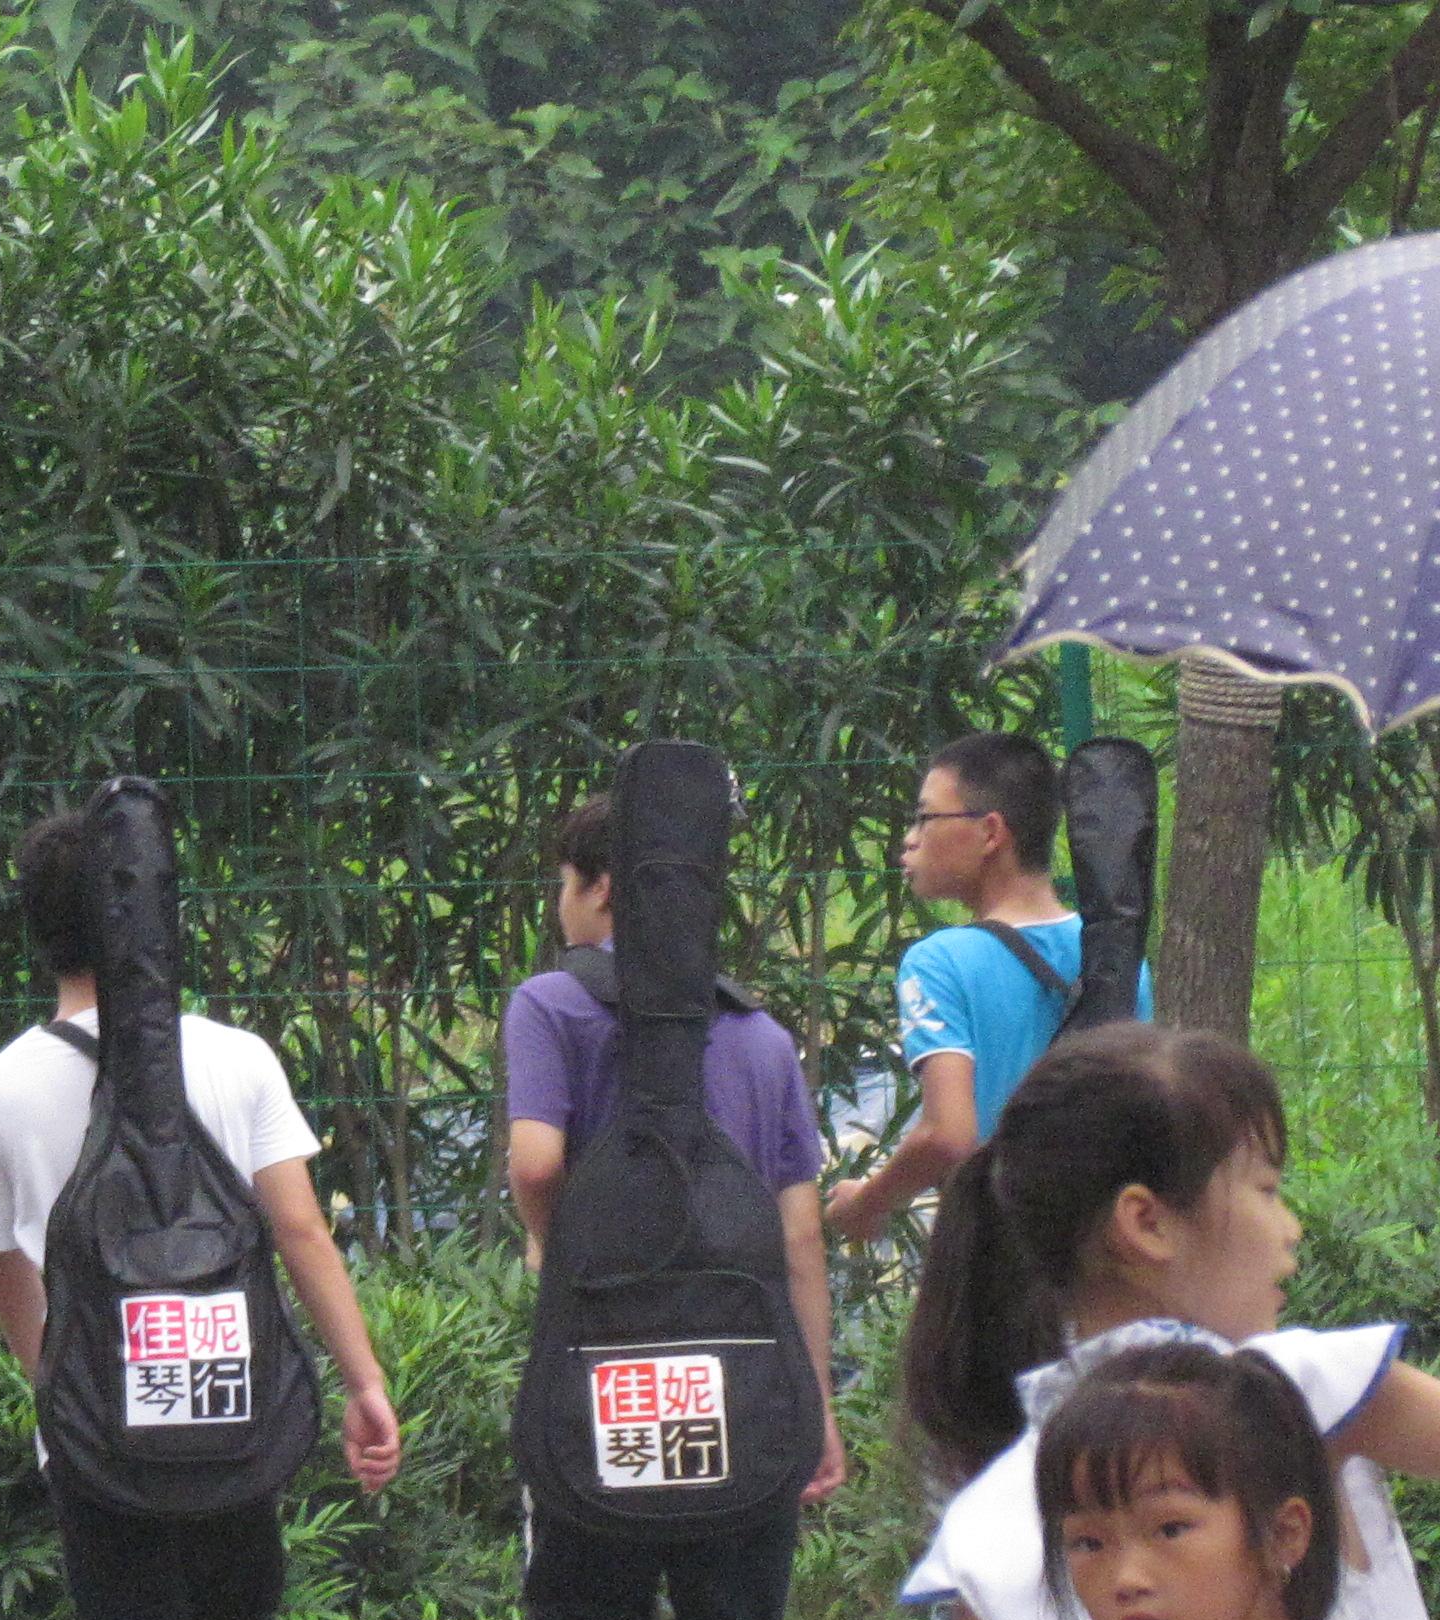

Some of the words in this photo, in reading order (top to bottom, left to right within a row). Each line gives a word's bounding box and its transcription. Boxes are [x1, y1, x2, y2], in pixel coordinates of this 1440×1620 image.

[131, 1303, 242, 1359] 佳妮
[136, 1361, 245, 1417] 琴行
[600, 1365, 715, 1422] 佳妮
[606, 1425, 719, 1478] 琴行
